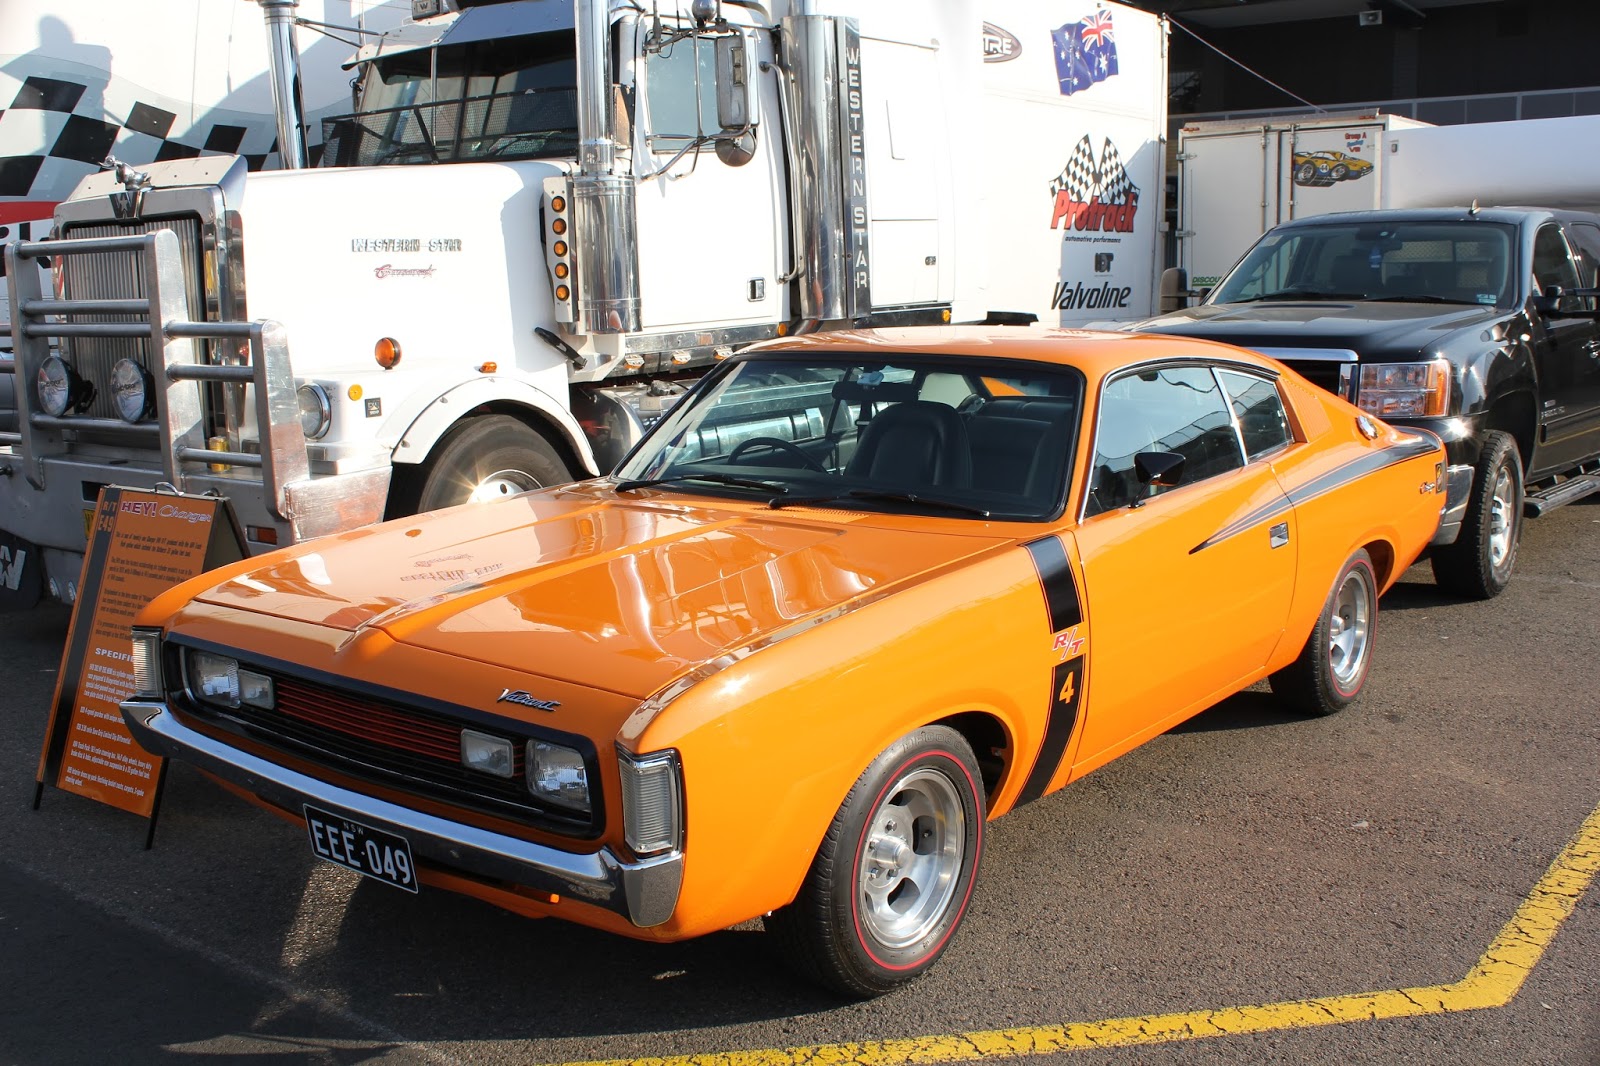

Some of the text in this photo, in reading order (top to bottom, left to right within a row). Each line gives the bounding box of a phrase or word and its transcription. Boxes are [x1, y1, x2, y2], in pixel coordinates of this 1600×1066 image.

[846, 48, 867, 289] WESTERN STAR
[1050, 188, 1137, 233] Protrack
[351, 239, 462, 252] WESTERN STAR
[1065, 235, 1121, 244] automotive performance
[1051, 281, 1131, 310] Valvoline
[121, 501, 212, 523] HEY! Charger
[1053, 626, 1085, 660] R/T
[497, 688, 562, 712] Valiant
[1059, 671, 1074, 704] 4
[343, 822, 364, 835] NSW
